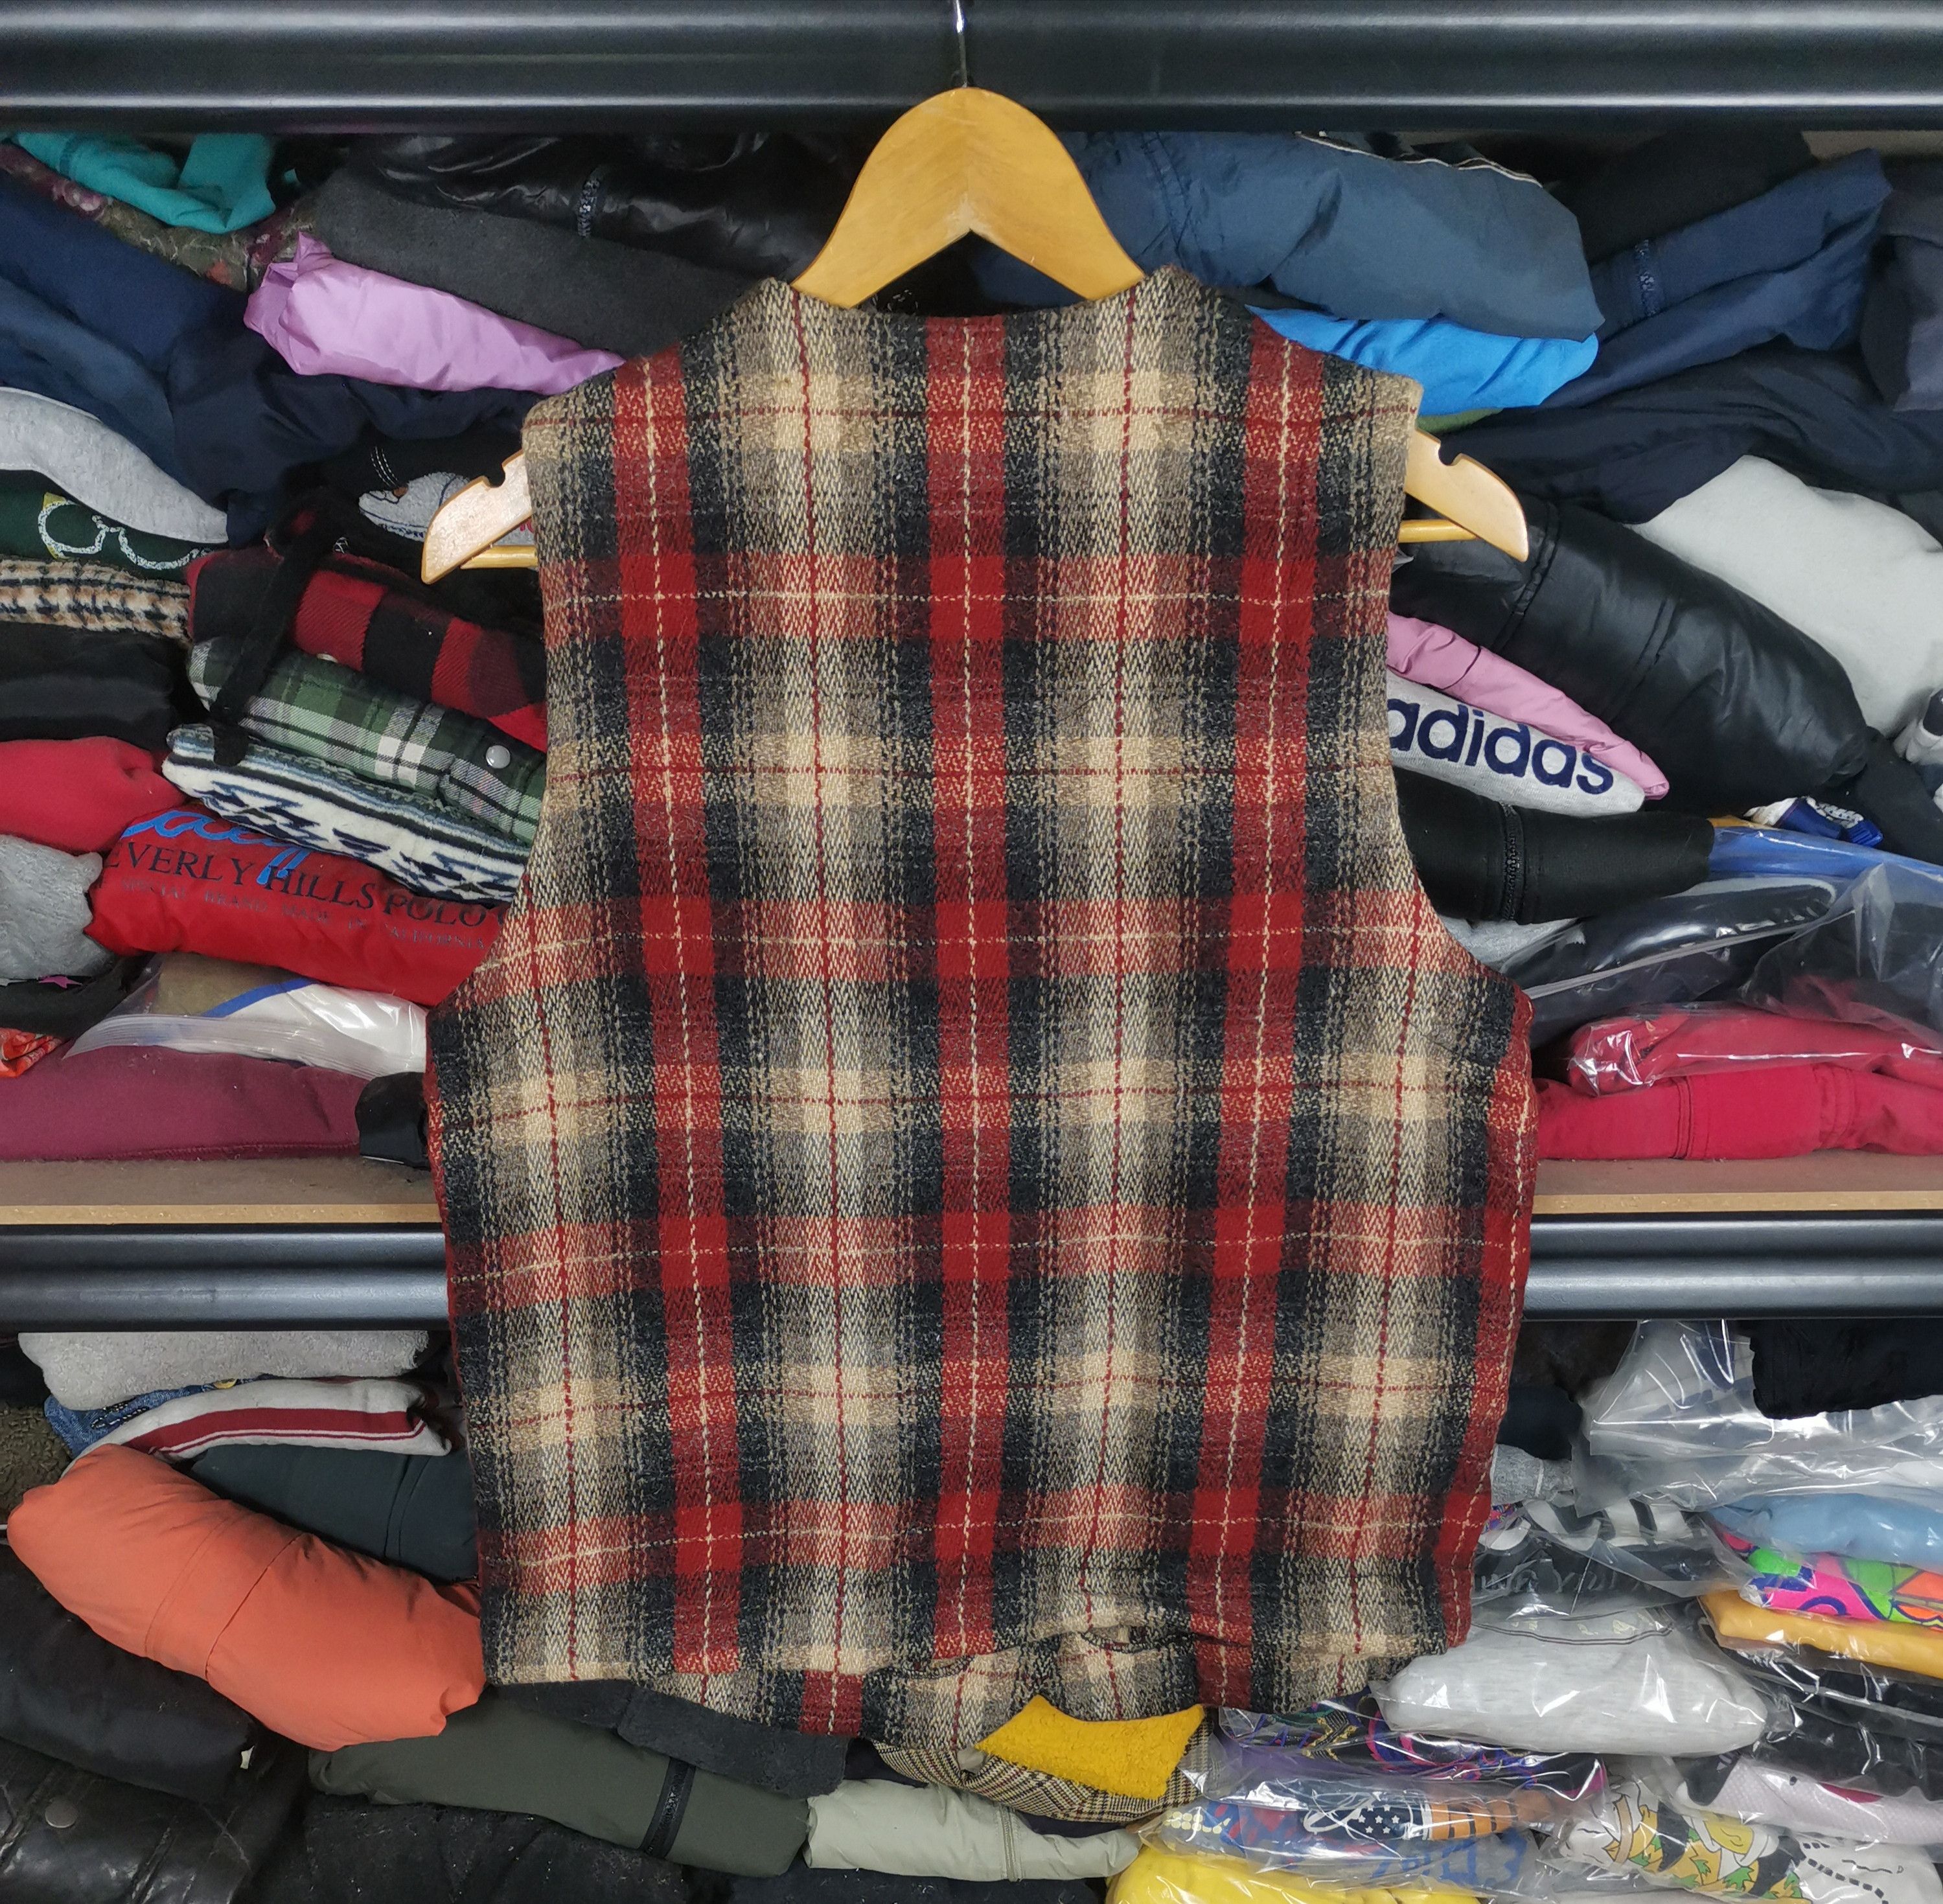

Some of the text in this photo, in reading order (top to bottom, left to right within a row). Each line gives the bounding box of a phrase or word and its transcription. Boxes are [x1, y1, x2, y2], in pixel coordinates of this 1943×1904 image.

[1387, 698, 1614, 795] adidas
[264, 865, 375, 910] HILLS
[383, 893, 487, 927] POLO
